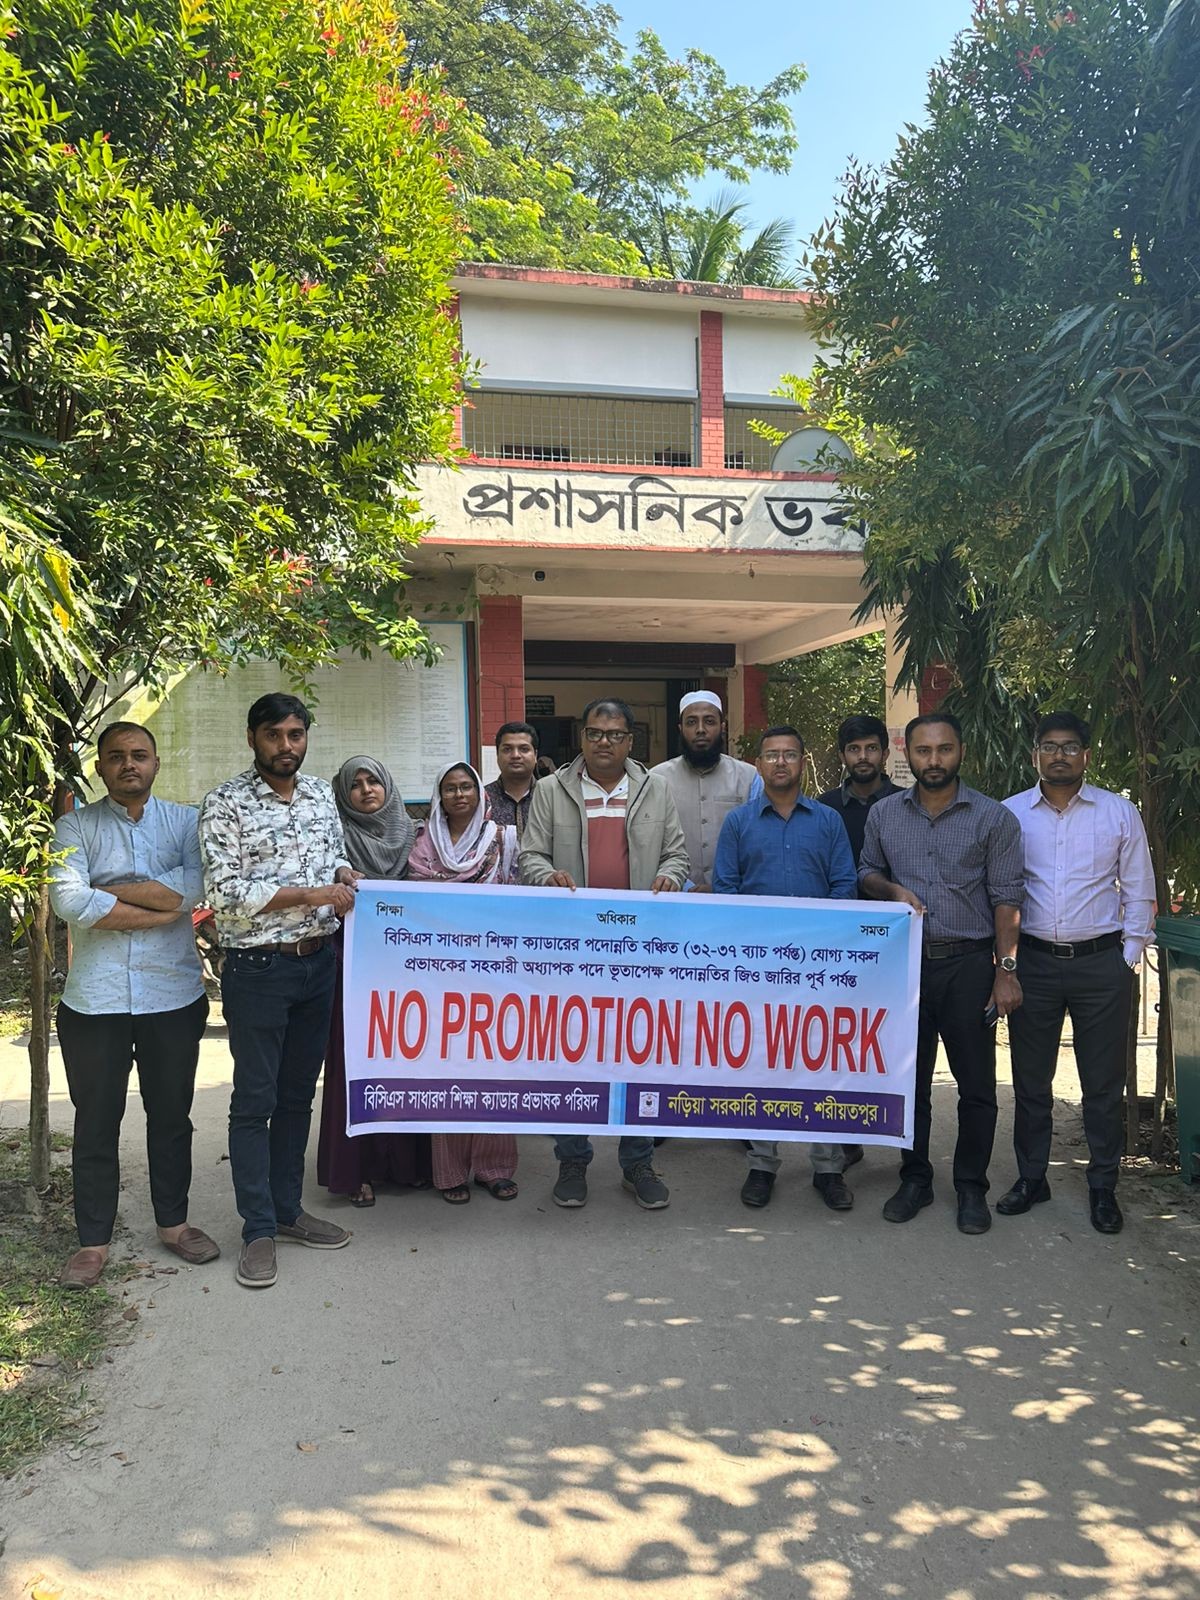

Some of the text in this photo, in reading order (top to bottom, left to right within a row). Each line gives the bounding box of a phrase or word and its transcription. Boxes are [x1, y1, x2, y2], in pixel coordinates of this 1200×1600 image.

[463, 474, 748, 535] প্রশাসনিক
[376, 901, 404, 917] শিক্ষা
[597, 910, 637, 926] অধিকার
[384, 927, 880, 964] বিসিএস সাধারণ শিক্ষা ক্যাডারের পদোন্নতি বঞ্চিত (৩২-৩৭ ব্যাচ পর্যন্ত) যোগ্য সকল
[860, 924, 889, 937] সমতা
[404, 956, 857, 991] প্রভাষকের সহকারী অধ্যাপক পদে ভূতাপেক্ষ পদোন্নতির জিও জারির পূর্ব পর্যন্ত
[367, 990, 887, 1074] NO PROMOTION NO WORK
[364, 1084, 599, 1112] বিসিএস সাধারণ শিক্ষা ক্যাডার প্রভাষক পরিষদ
[667, 1090, 705, 1118] নড়িয়া
[709, 1093, 758, 1118] সরকারি
[761, 1098, 809, 1123] কলেজ,
